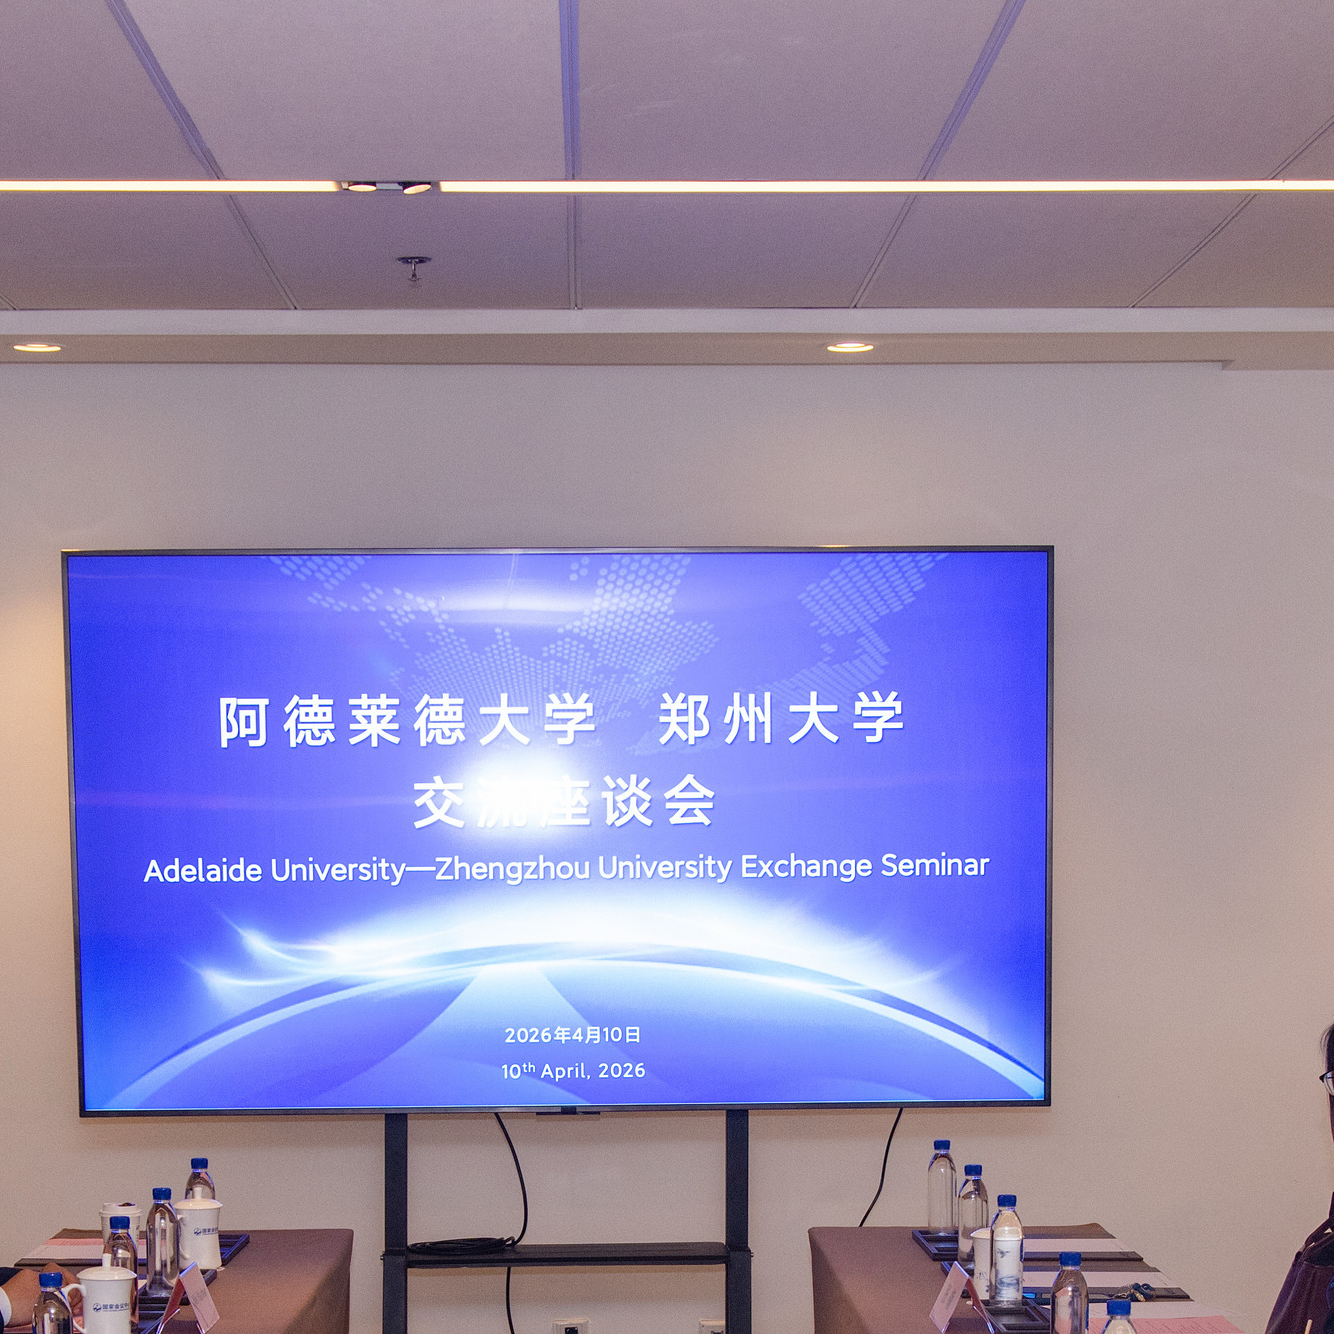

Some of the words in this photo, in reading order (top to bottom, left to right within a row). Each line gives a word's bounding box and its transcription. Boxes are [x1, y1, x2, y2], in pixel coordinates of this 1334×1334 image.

[220, 693, 596, 748] 阿德莱德大学
[659, 690, 904, 744] 郑州大学
[143, 857, 263, 883] Adelaide
[599, 854, 733, 884] University
[741, 852, 873, 883] Exchange
[881, 851, 991, 877] Seminar
[504, 1026, 641, 1044] 2026年4月10日
[501, 1061, 536, 1079] 10th
[540, 1062, 591, 1082] April,
[598, 1062, 646, 1078] 2026
